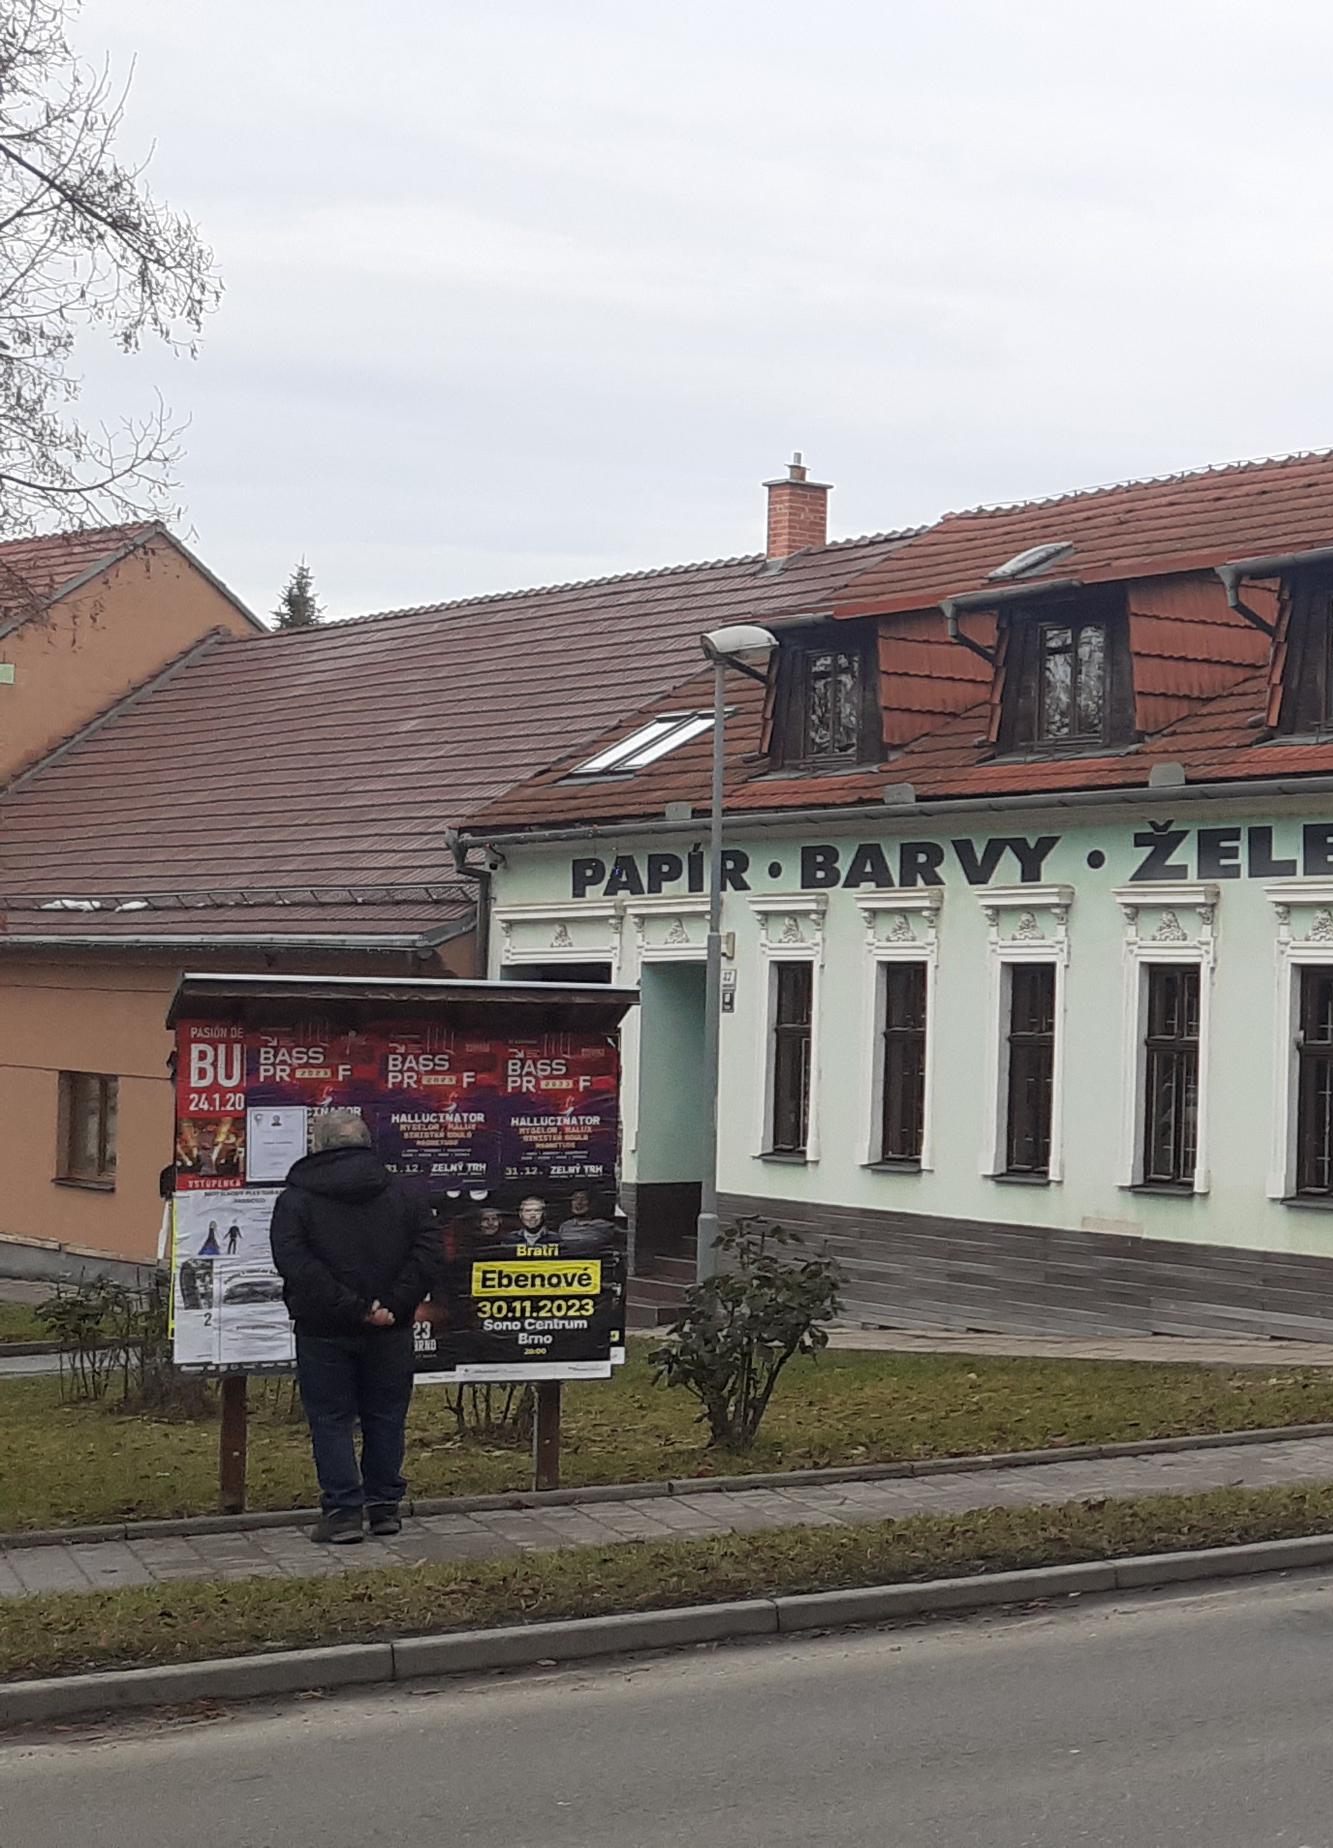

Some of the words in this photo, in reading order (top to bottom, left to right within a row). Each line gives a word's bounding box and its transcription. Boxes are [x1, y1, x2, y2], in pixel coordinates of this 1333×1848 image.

[571, 842, 752, 899] PAPÍR
[800, 836, 1061, 889] BARVY
[190, 1027, 227, 1039] PASIÓN
[230, 1027, 244, 1039] DE
[259, 1048, 325, 1065] BASS
[387, 1055, 450, 1071] BASS
[189, 1043, 247, 1088] BU
[259, 1066, 291, 1082] PR
[338, 1065, 352, 1082] F
[507, 1060, 567, 1076] BASS
[387, 1072, 418, 1088] PR
[462, 1072, 476, 1088] F
[507, 1077, 536, 1092] PR
[578, 1076, 592, 1092] F
[391, 1113, 485, 1123] HALLUCINATOR
[510, 1116, 600, 1126] HALLUCINATOR
[431, 1161, 463, 1172] ZELNÝ
[467, 1162, 487, 1173] TRH
[550, 1163, 581, 1174] ZELNÝ
[583, 1164, 603, 1174] TRH
[516, 1244, 559, 1256] Bratři
[481, 1267, 593, 1289] Ebenové
[477, 1299, 594, 1318] 30.11.2023
[483, 1319, 521, 1330] Sono
[524, 1318, 588, 1330] Centrum
[518, 1332, 553, 1345] Brno
